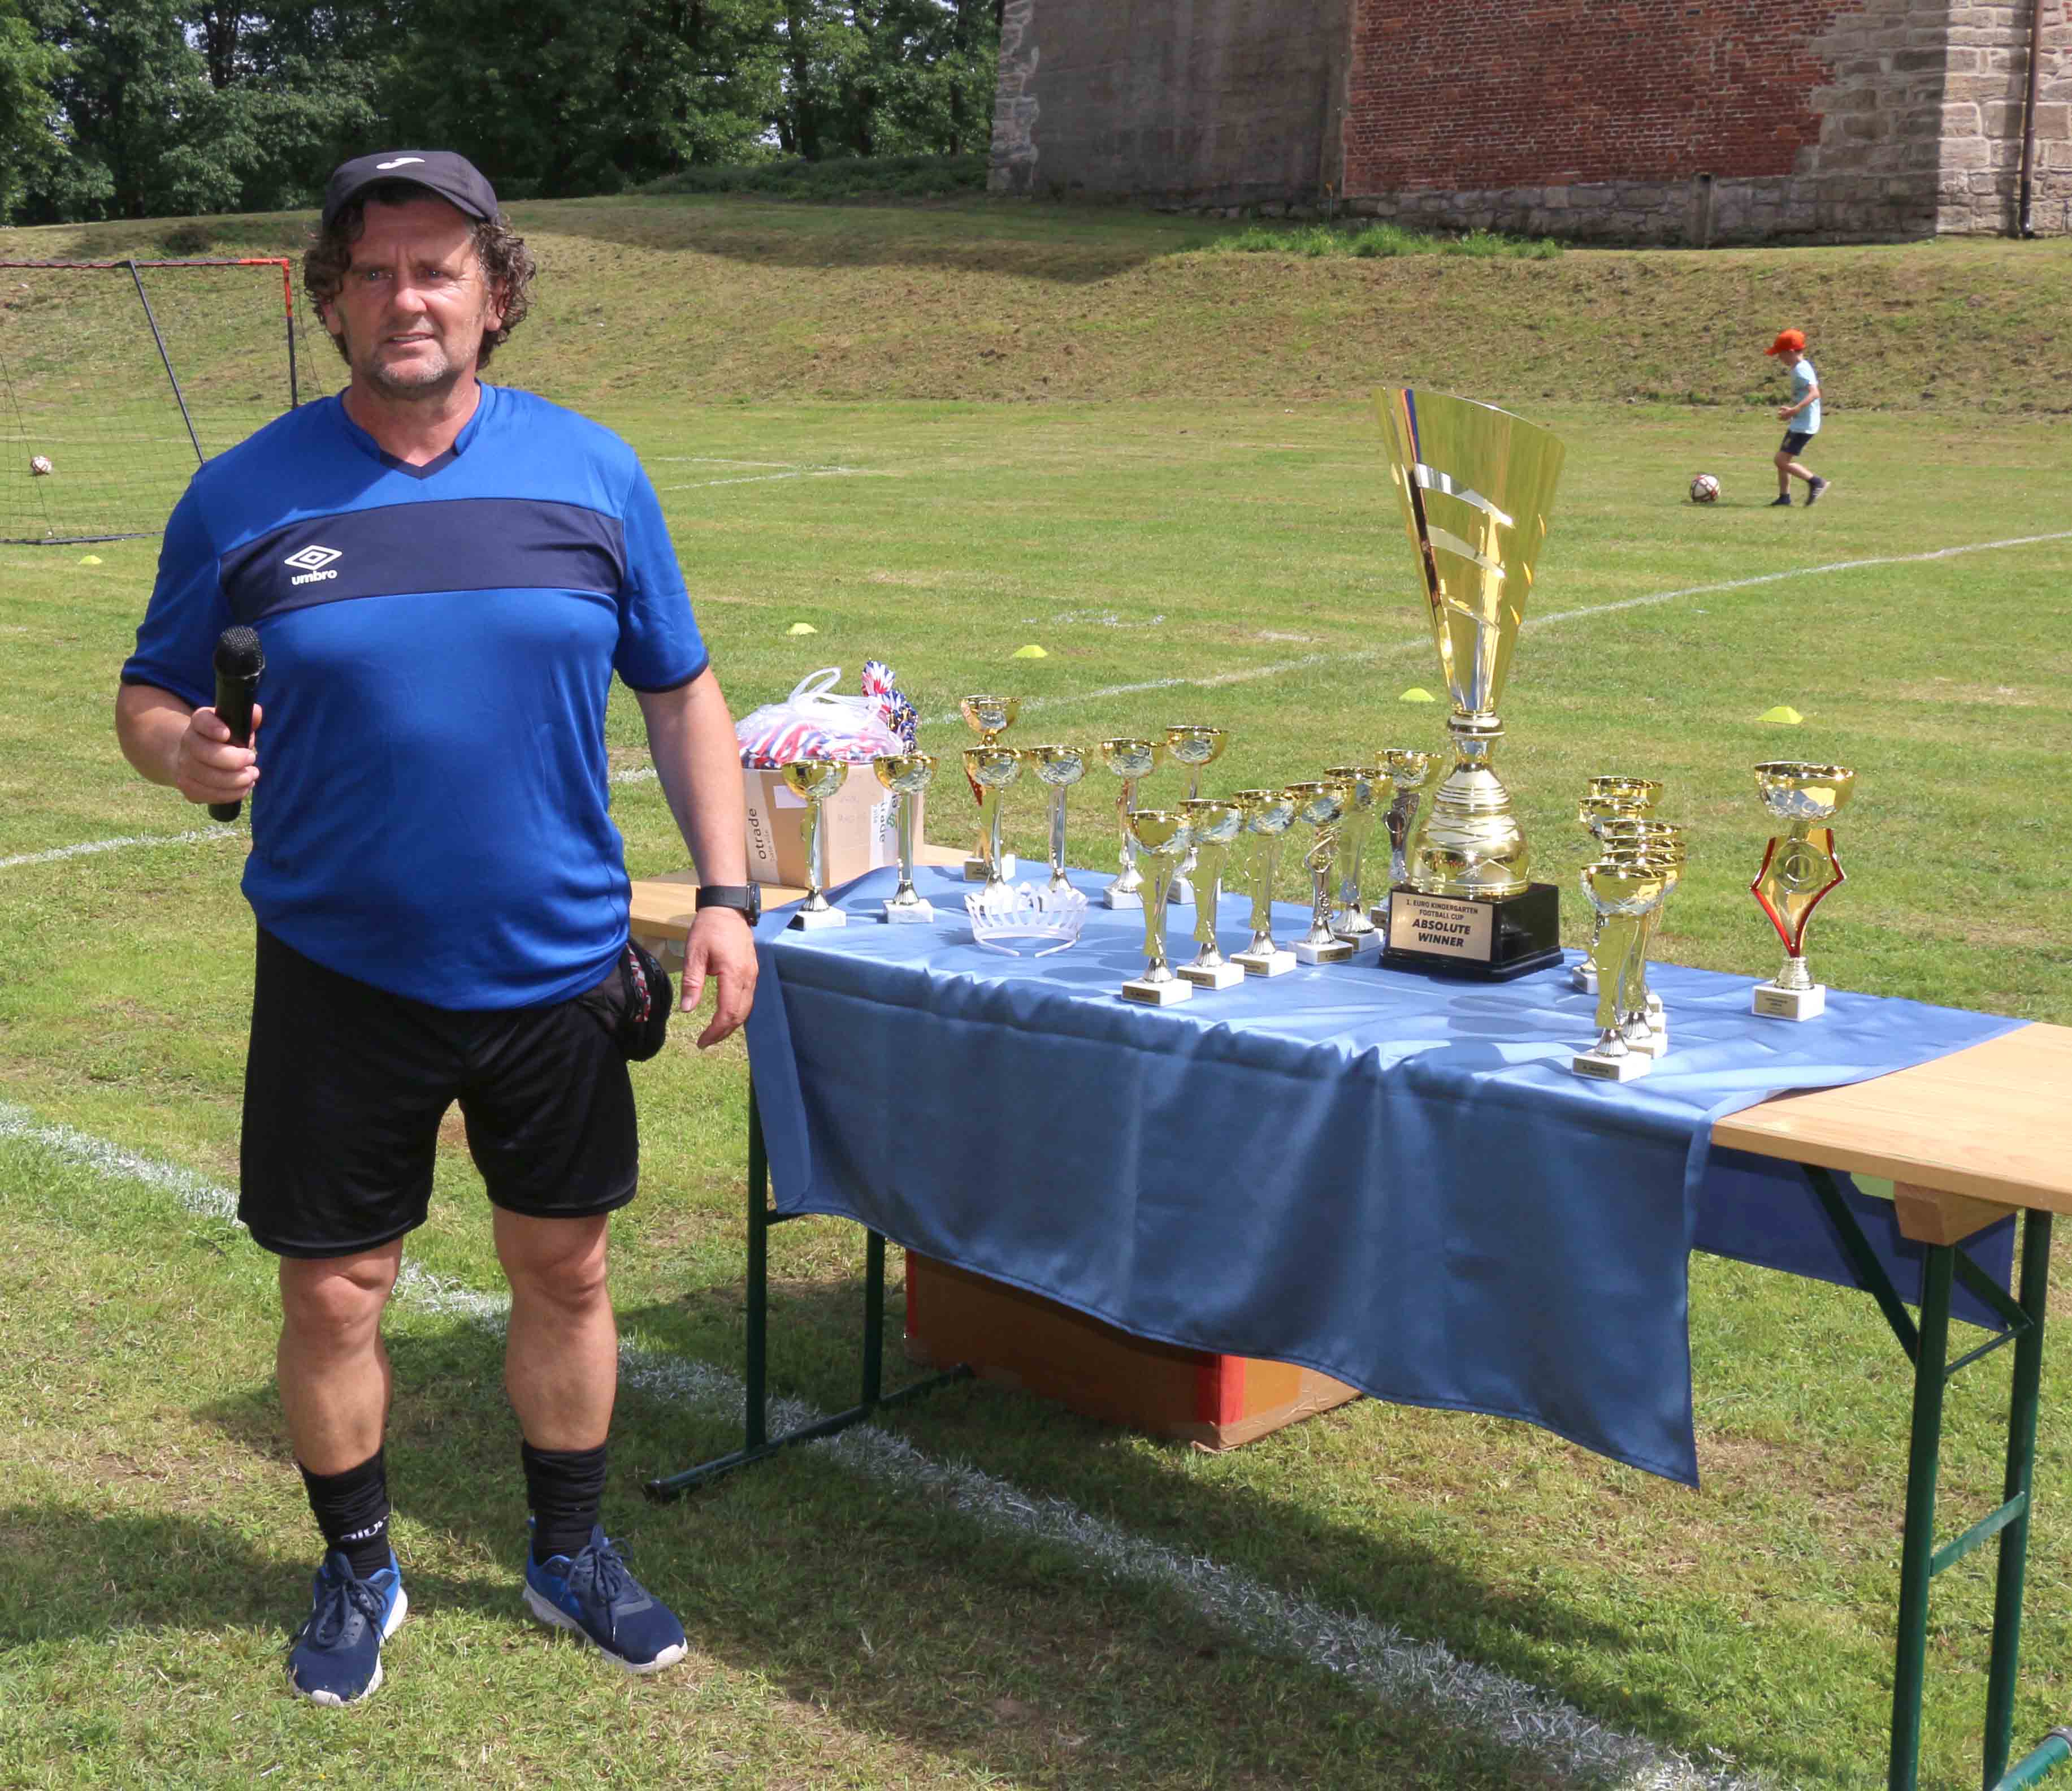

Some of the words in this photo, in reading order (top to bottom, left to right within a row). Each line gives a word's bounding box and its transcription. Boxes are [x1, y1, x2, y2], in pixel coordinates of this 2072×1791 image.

[291, 570, 338, 585] umbro
[1414, 899, 1430, 909] EURO
[1431, 902, 1479, 914] KINDERGARTEN
[1419, 909, 1450, 919] FOOTBALL
[1412, 918, 1472, 935] ABSOLUTE
[1418, 932, 1465, 948] WINNER
